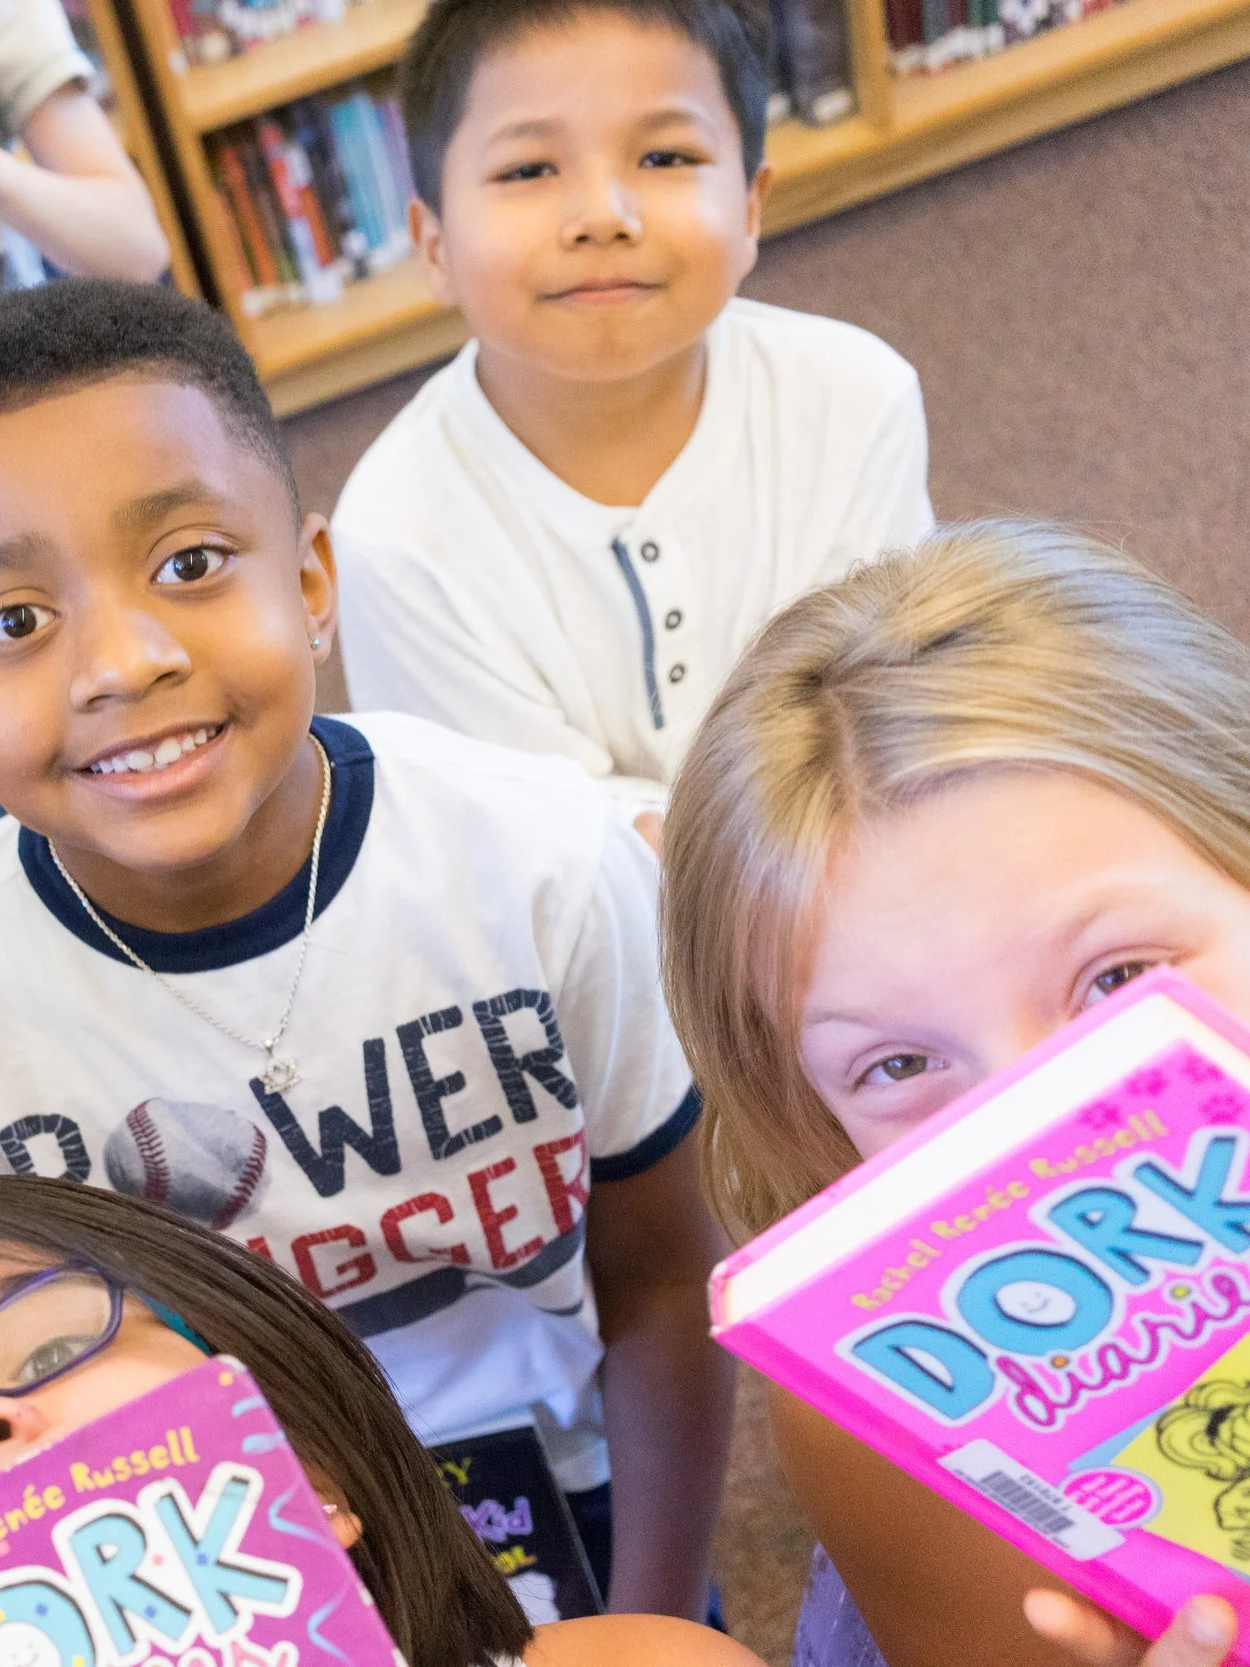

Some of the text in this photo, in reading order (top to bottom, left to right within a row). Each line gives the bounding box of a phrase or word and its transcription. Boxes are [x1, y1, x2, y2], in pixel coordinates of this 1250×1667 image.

[842, 1133, 1250, 1420] DORK
[851, 1108, 1170, 1311] Rachel Renée Russell
[70, 1425, 200, 1494] Russell
